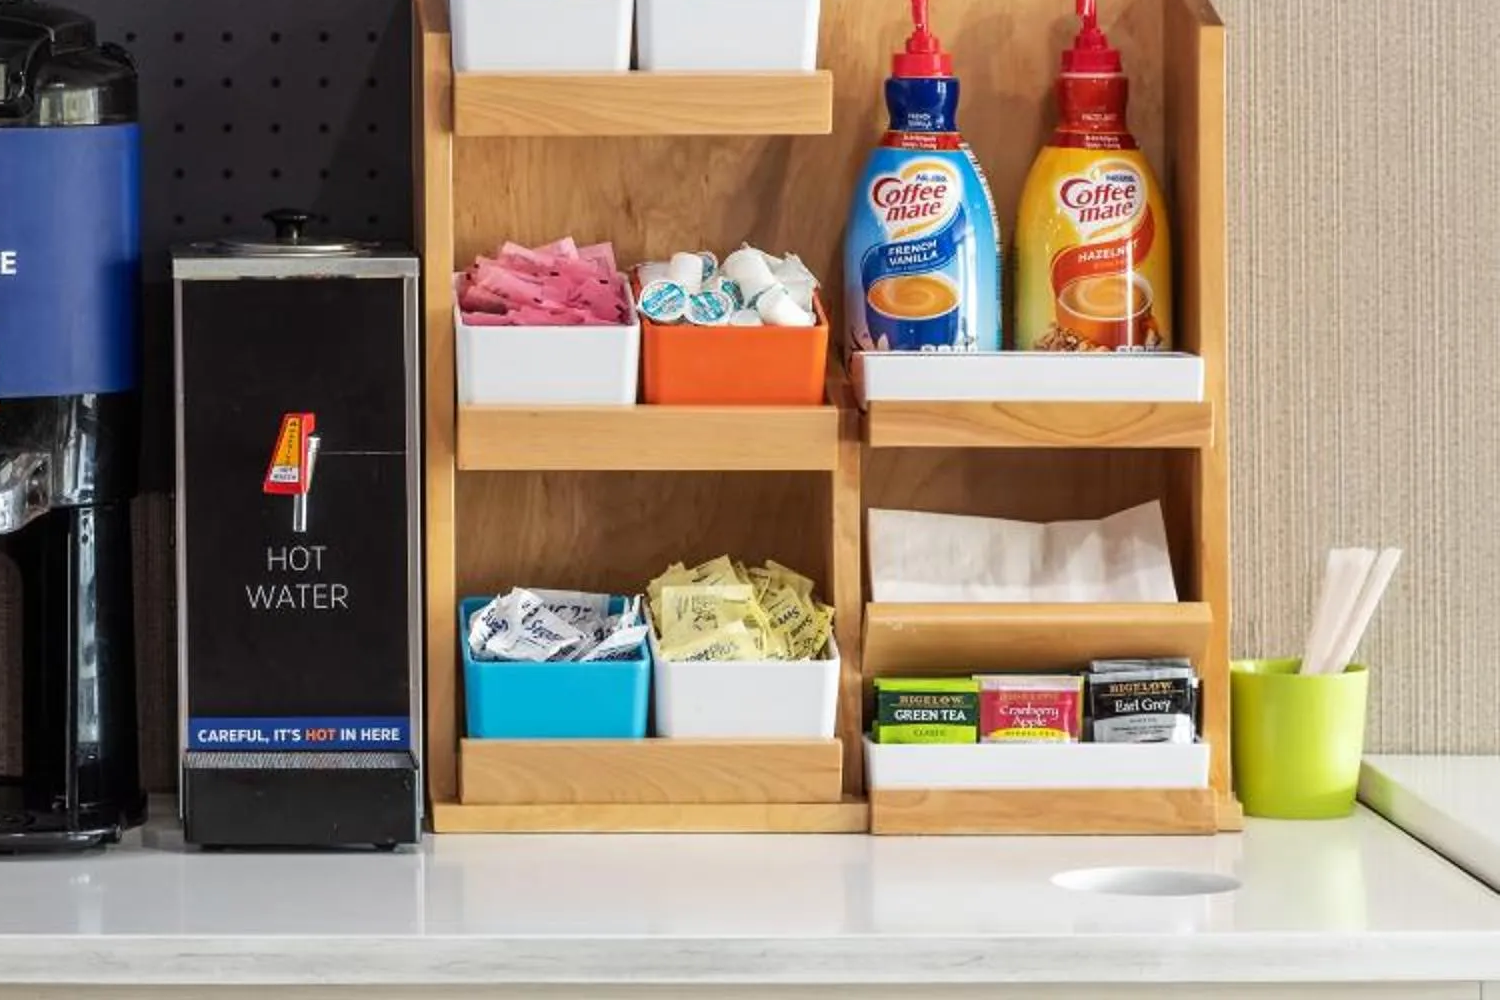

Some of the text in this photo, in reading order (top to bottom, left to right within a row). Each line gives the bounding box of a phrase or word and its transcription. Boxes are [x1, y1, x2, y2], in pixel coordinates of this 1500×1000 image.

[872, 177, 947, 208] Coffee
[1060, 178, 1136, 209] Coffee
[885, 201, 941, 222] mate
[1078, 201, 1134, 223] mate
[887, 239, 937, 256] FRENCH
[888, 250, 938, 266] VANILLA
[267, 546, 327, 571] HOT
[246, 584, 349, 609] WATER
[900, 695, 965, 705] BIGELOW
[1115, 698, 1171, 714] Earl Grey
[894, 709, 967, 721] GREEN TEA
[1000, 703, 1059, 718] Cranberry
[1012, 716, 1047, 729] Apple
[197, 728, 400, 743] CAREFUL, IT'S HOT IN HERE
